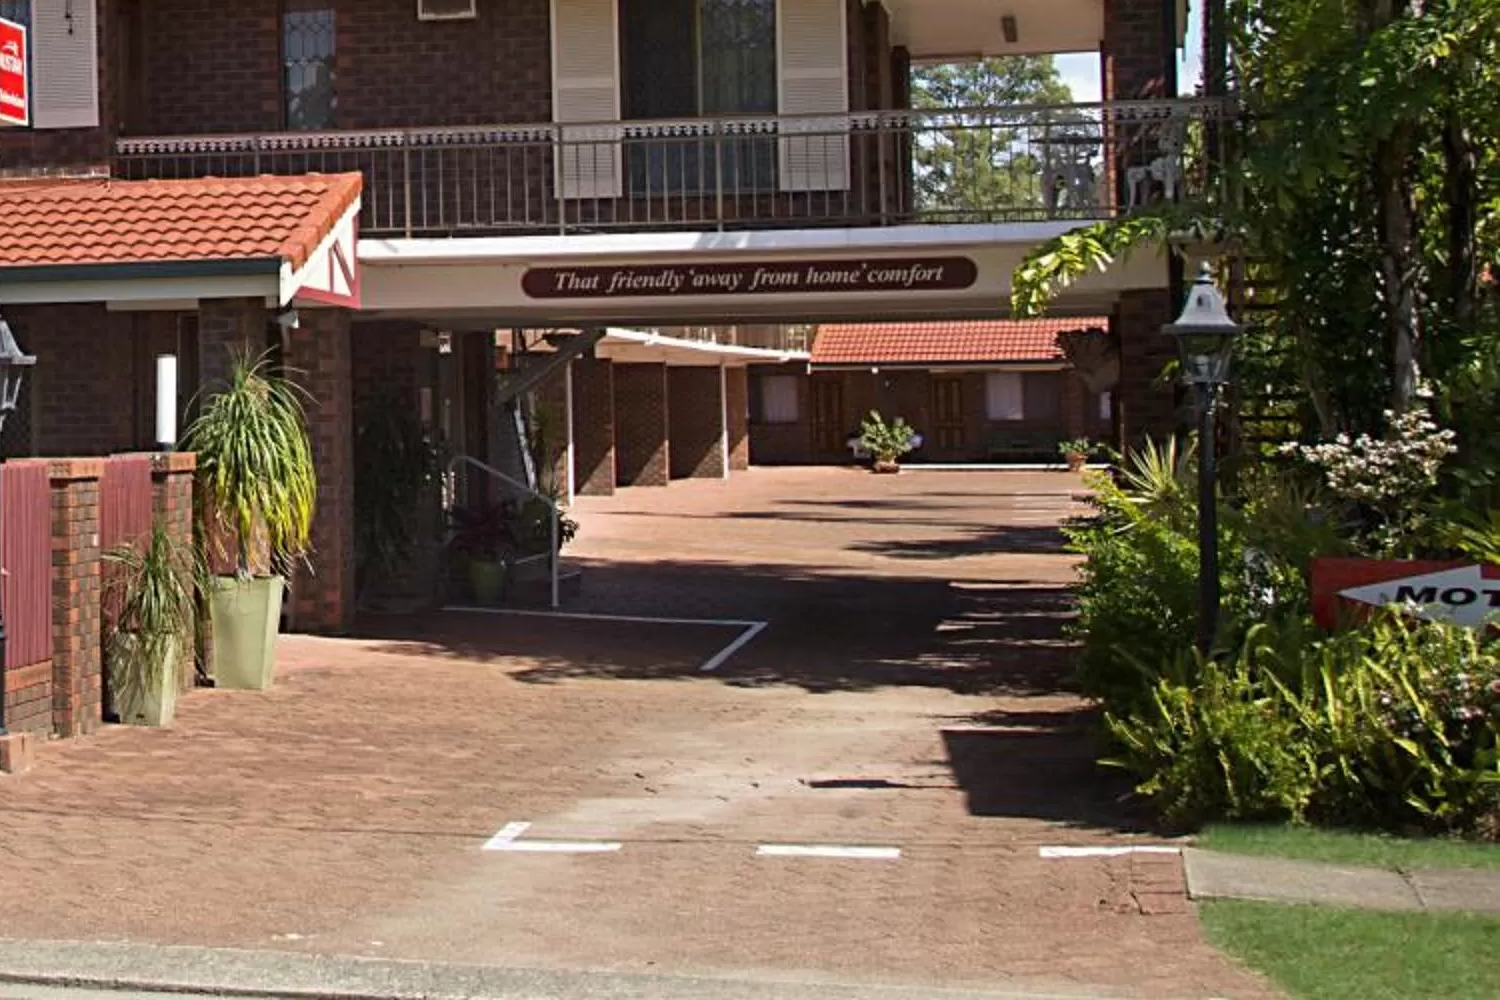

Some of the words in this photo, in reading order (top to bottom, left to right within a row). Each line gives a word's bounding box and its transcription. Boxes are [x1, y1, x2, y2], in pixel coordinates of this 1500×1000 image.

[555, 271, 599, 291] That
[605, 268, 684, 293] friendly
[748, 266, 799, 290] from
[867, 263, 944, 287] comfort
